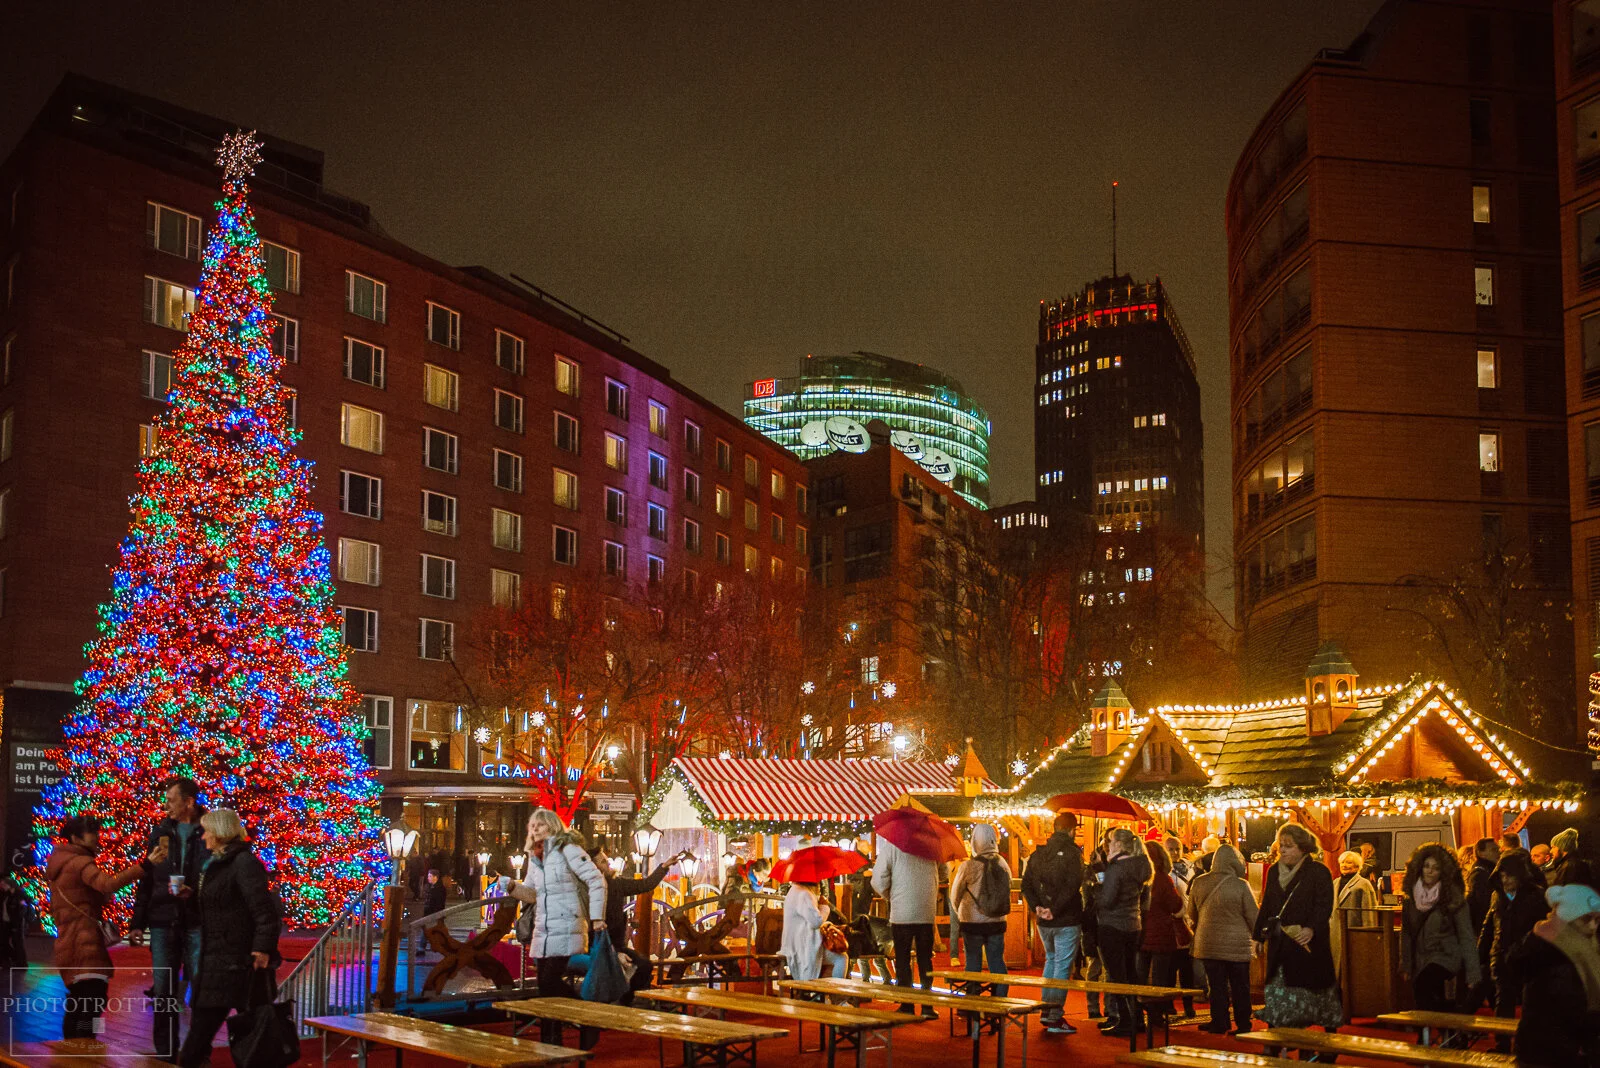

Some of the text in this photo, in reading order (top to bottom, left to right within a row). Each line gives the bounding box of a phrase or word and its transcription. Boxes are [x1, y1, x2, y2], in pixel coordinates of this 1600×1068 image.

[758, 382, 774, 395] DB
[16, 746, 45, 758] Dein
[15, 762, 36, 771] am
[15, 773, 60, 785] ist hier
